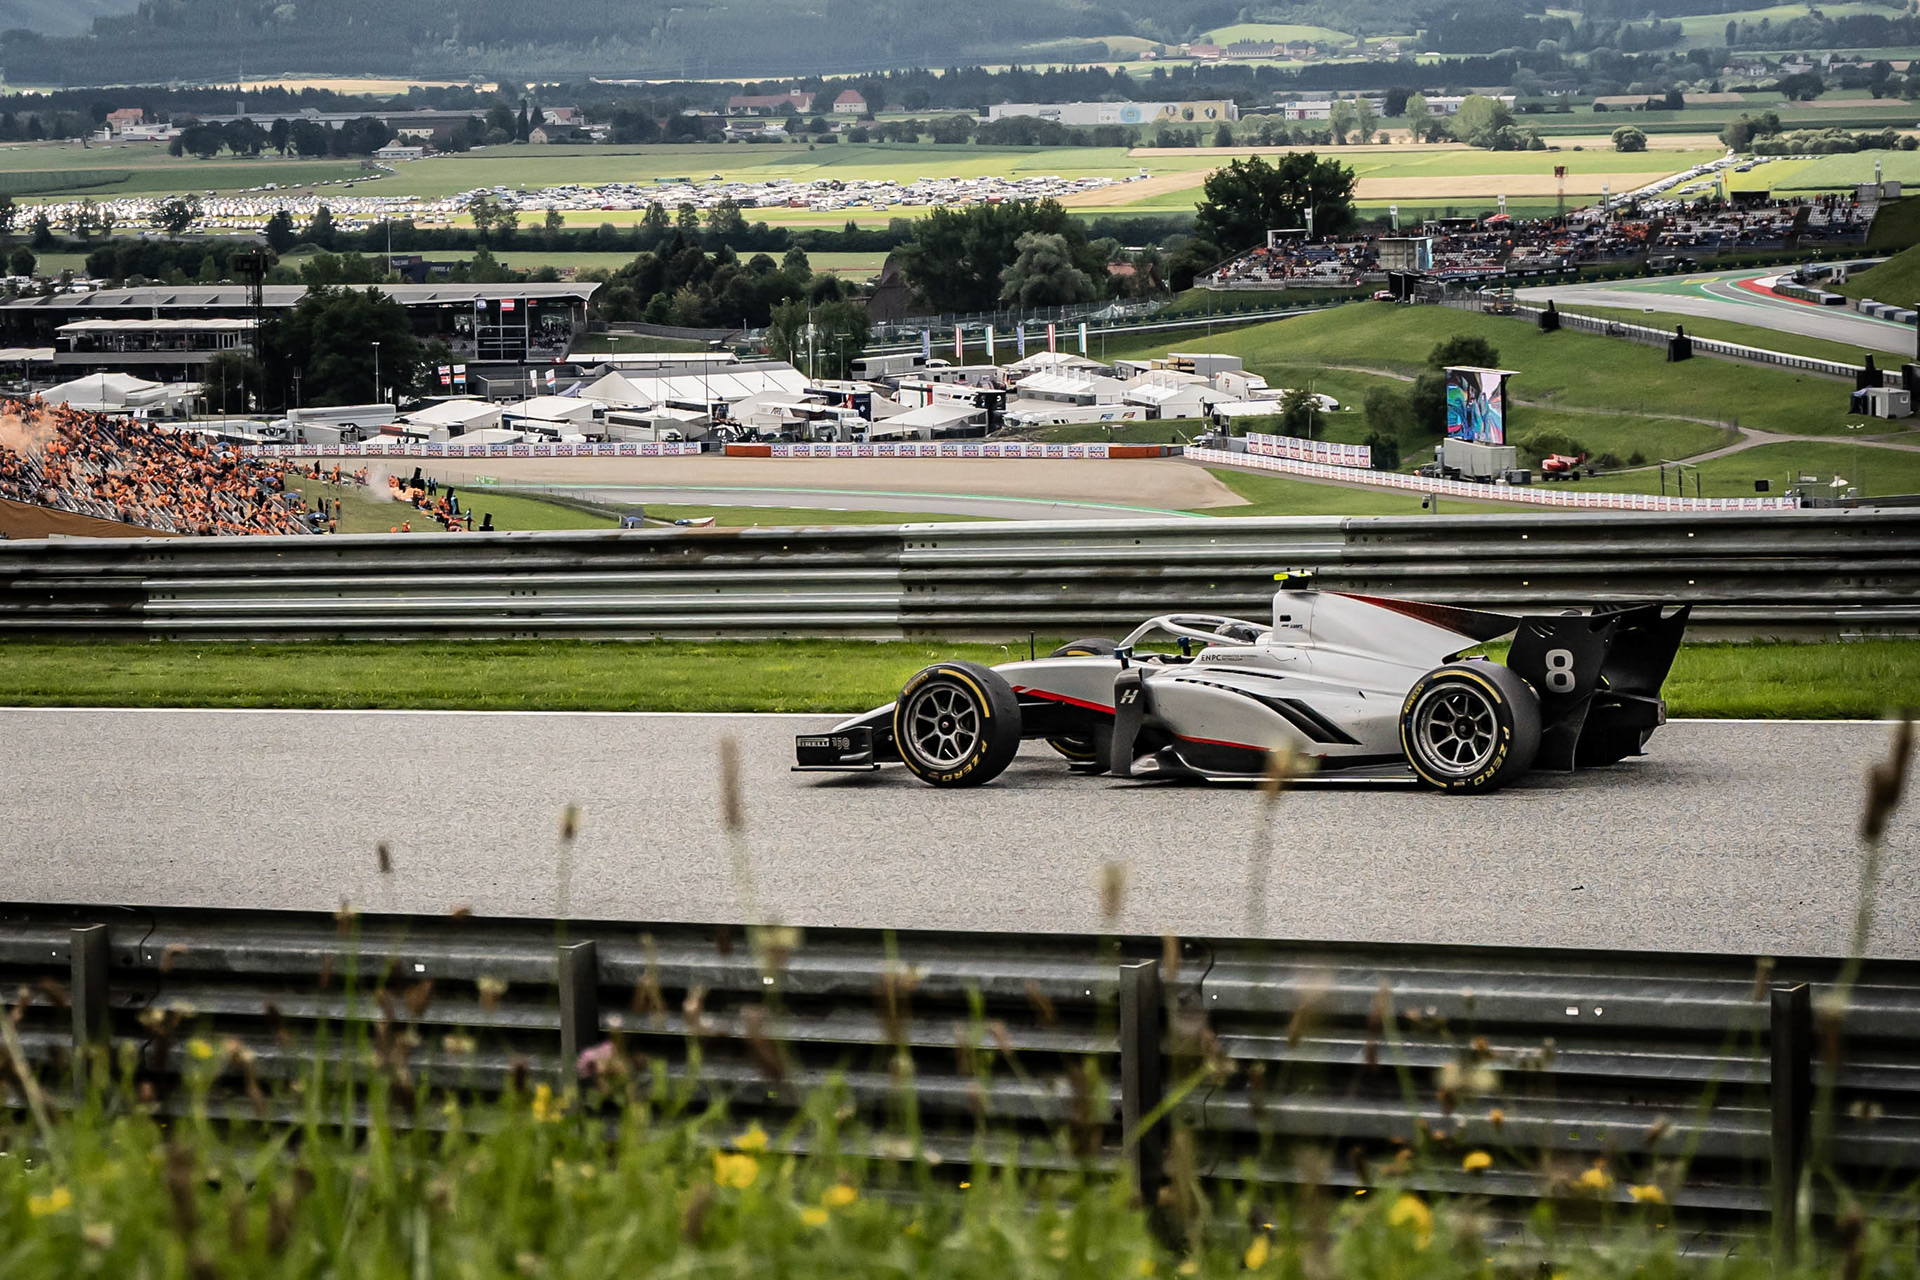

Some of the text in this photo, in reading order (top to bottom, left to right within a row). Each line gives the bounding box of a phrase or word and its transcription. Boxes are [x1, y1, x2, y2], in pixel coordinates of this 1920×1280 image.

[1545, 649, 1576, 693] 8
[797, 738, 830, 747] PIRELLI
[942, 740, 988, 782] P ZERO
[1474, 726, 1510, 786] P ZERO
